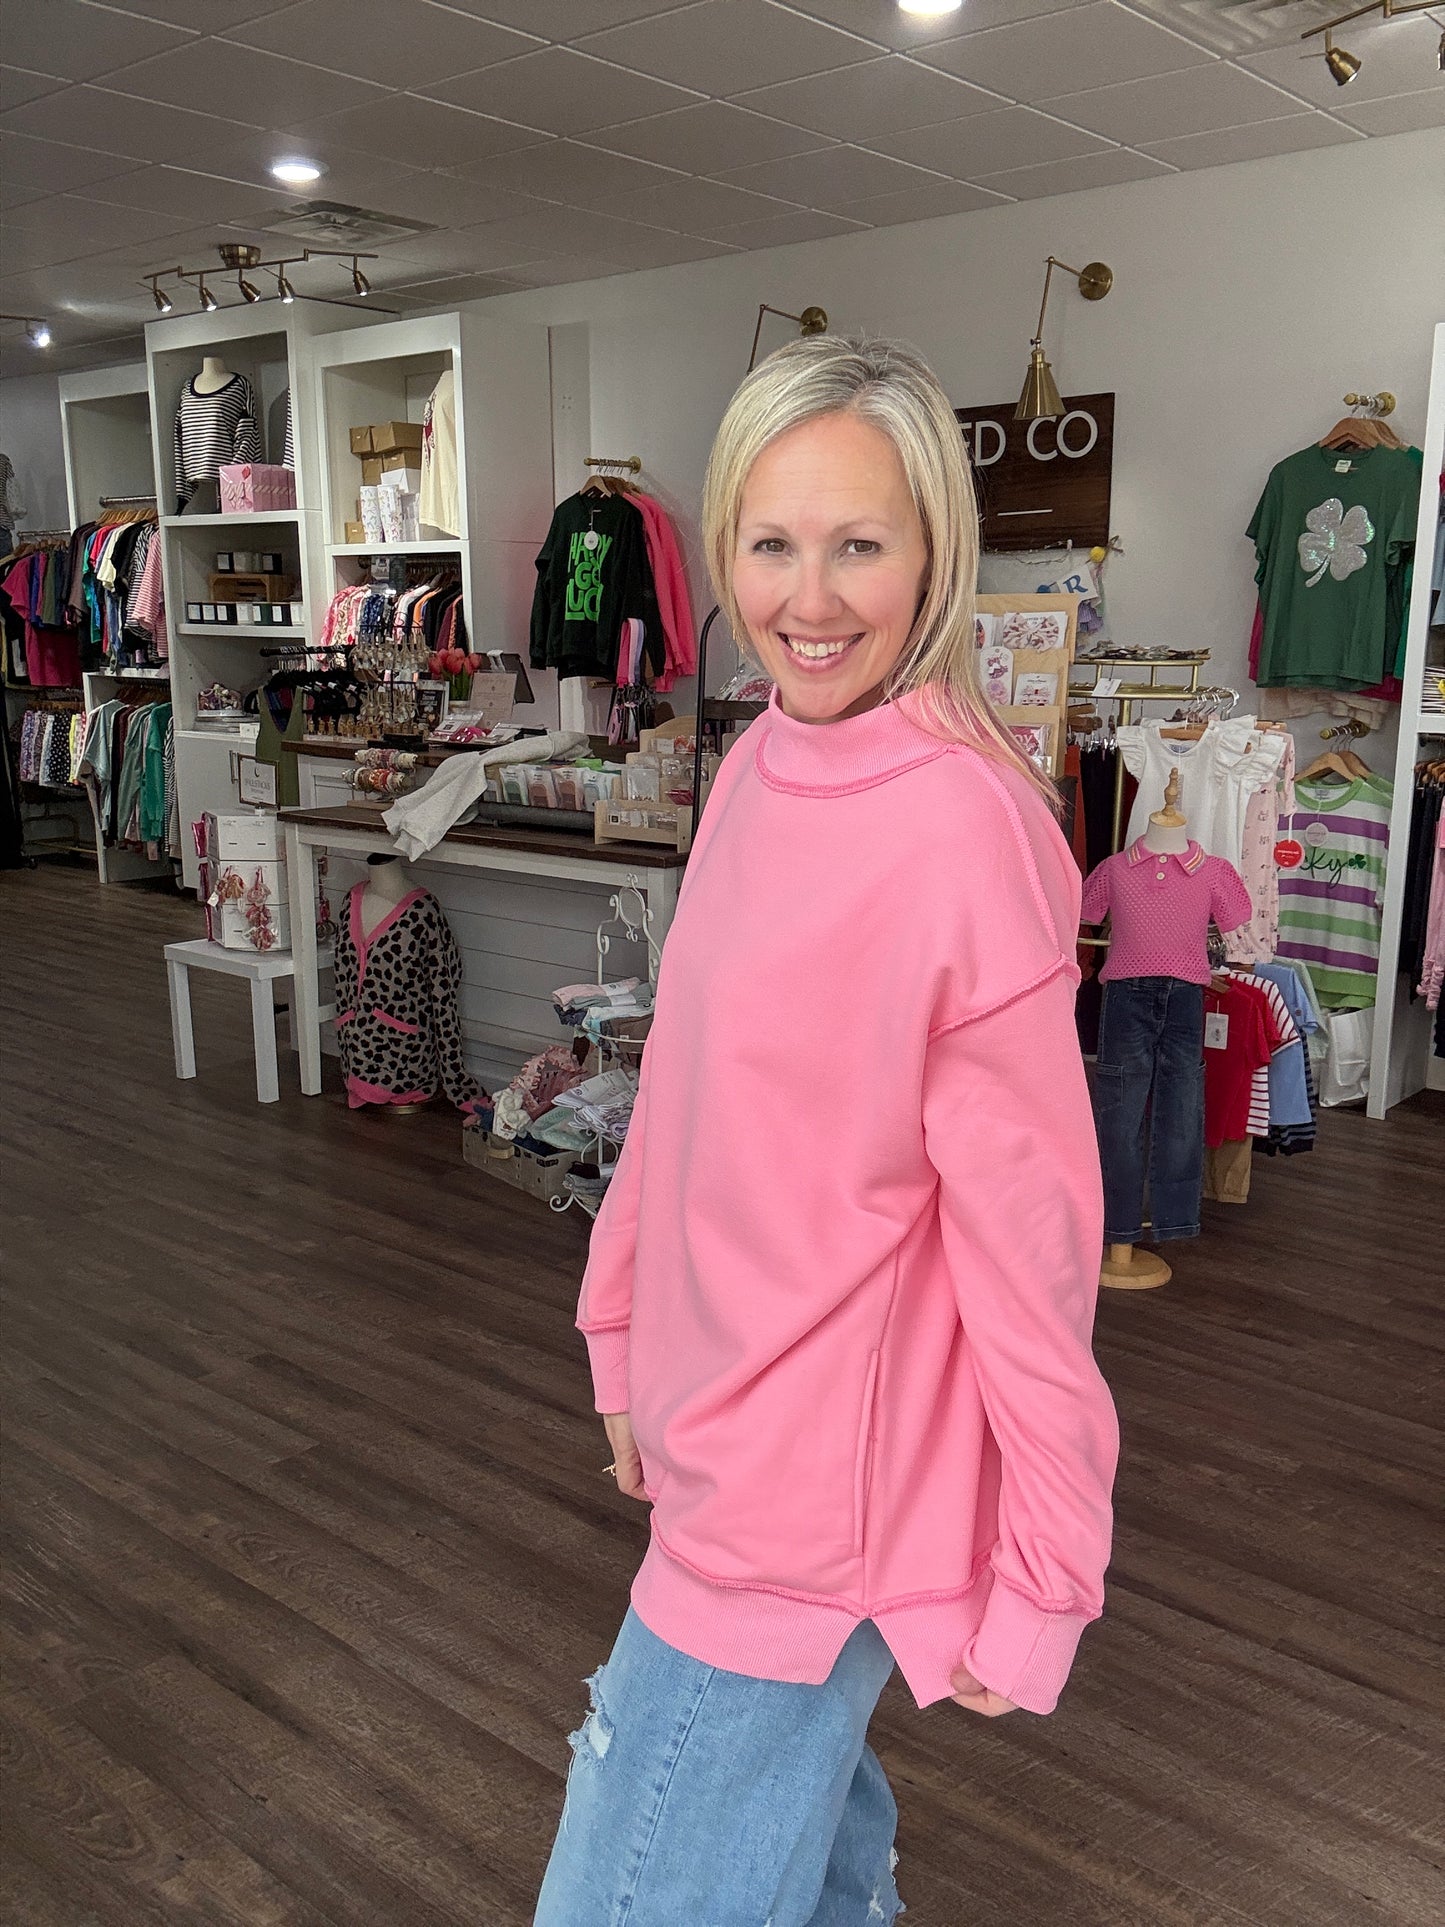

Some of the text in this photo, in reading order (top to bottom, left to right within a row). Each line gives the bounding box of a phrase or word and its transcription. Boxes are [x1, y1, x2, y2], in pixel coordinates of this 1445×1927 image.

[959, 410, 1098, 466] D CO
[1062, 575, 1088, 593] R
